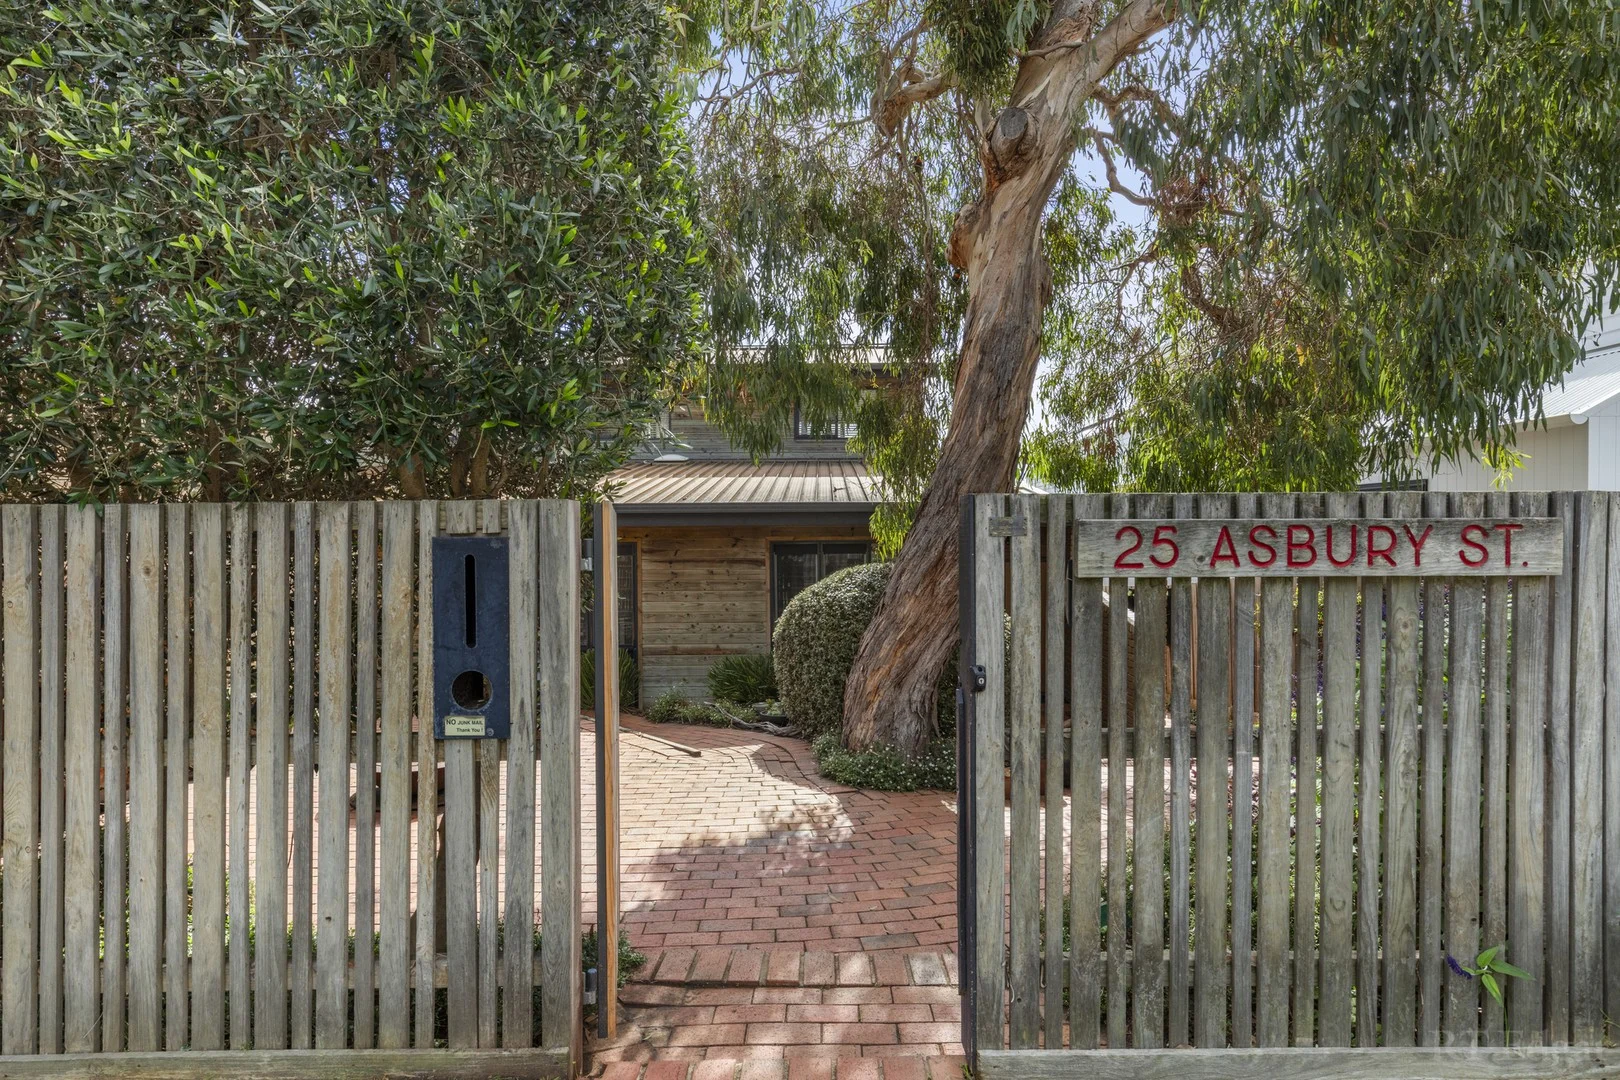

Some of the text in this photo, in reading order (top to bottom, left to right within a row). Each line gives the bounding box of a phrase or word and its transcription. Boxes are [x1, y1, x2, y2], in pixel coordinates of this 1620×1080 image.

[1114, 523, 1530, 569] 25 ASBURY ST.
